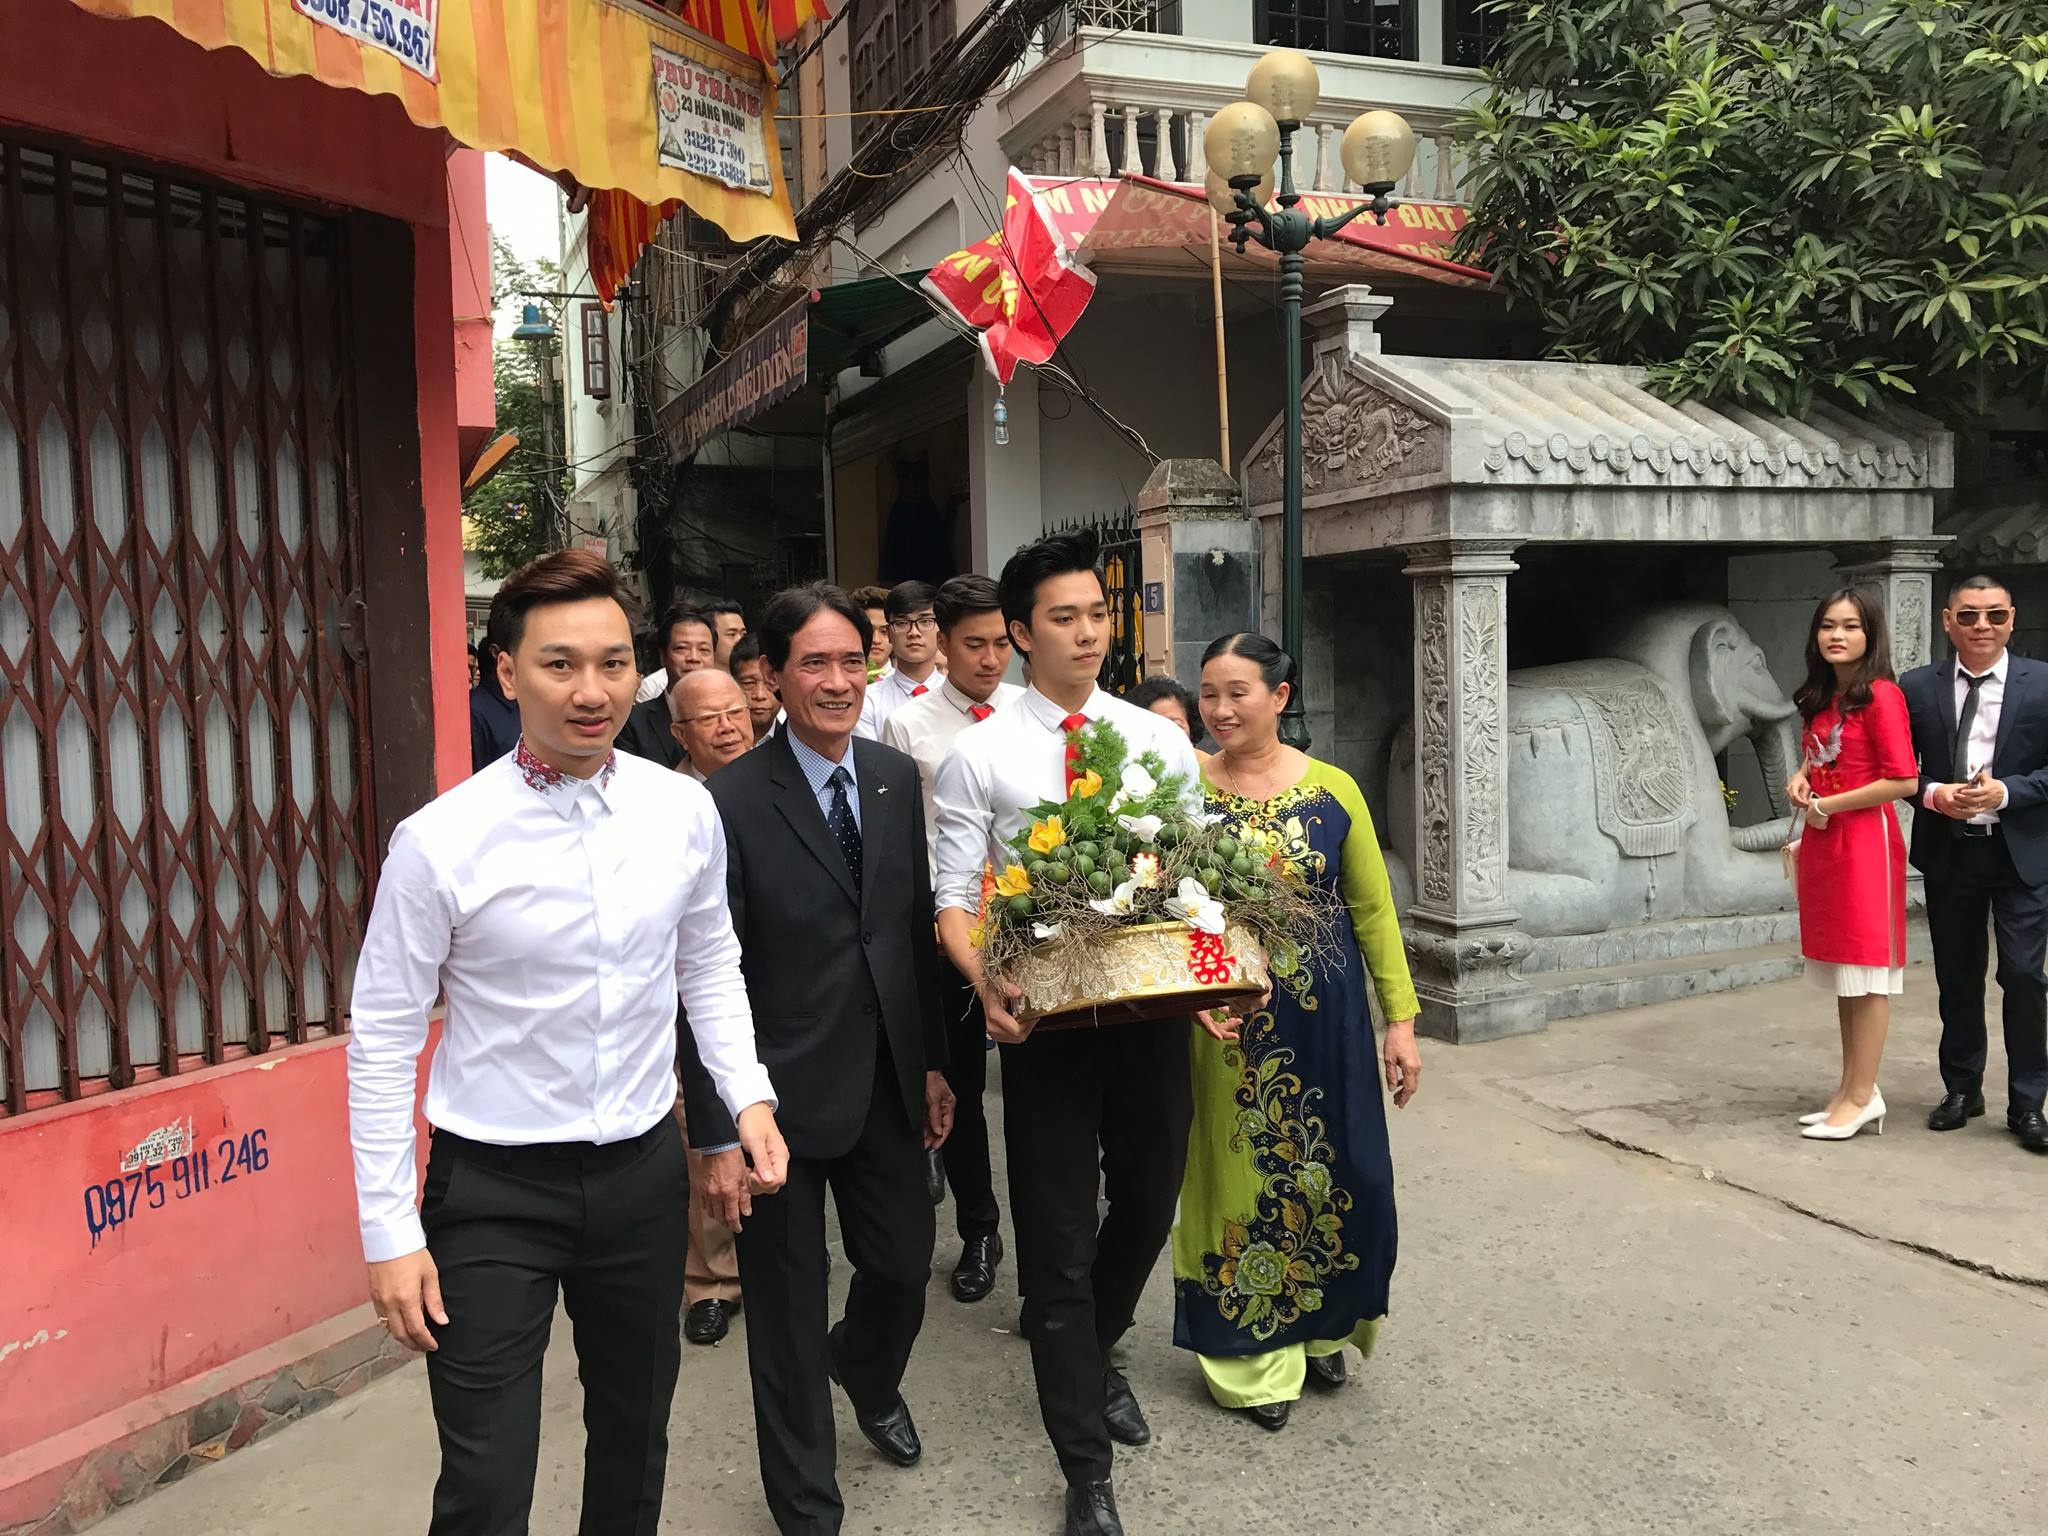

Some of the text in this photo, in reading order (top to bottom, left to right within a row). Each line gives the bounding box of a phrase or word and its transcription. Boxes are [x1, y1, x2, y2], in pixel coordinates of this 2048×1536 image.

[681, 94, 692, 113] 23
[694, 97, 720, 123] HÀNG
[684, 128, 745, 164] 3828.7390
[1151, 587, 1158, 608] 5
